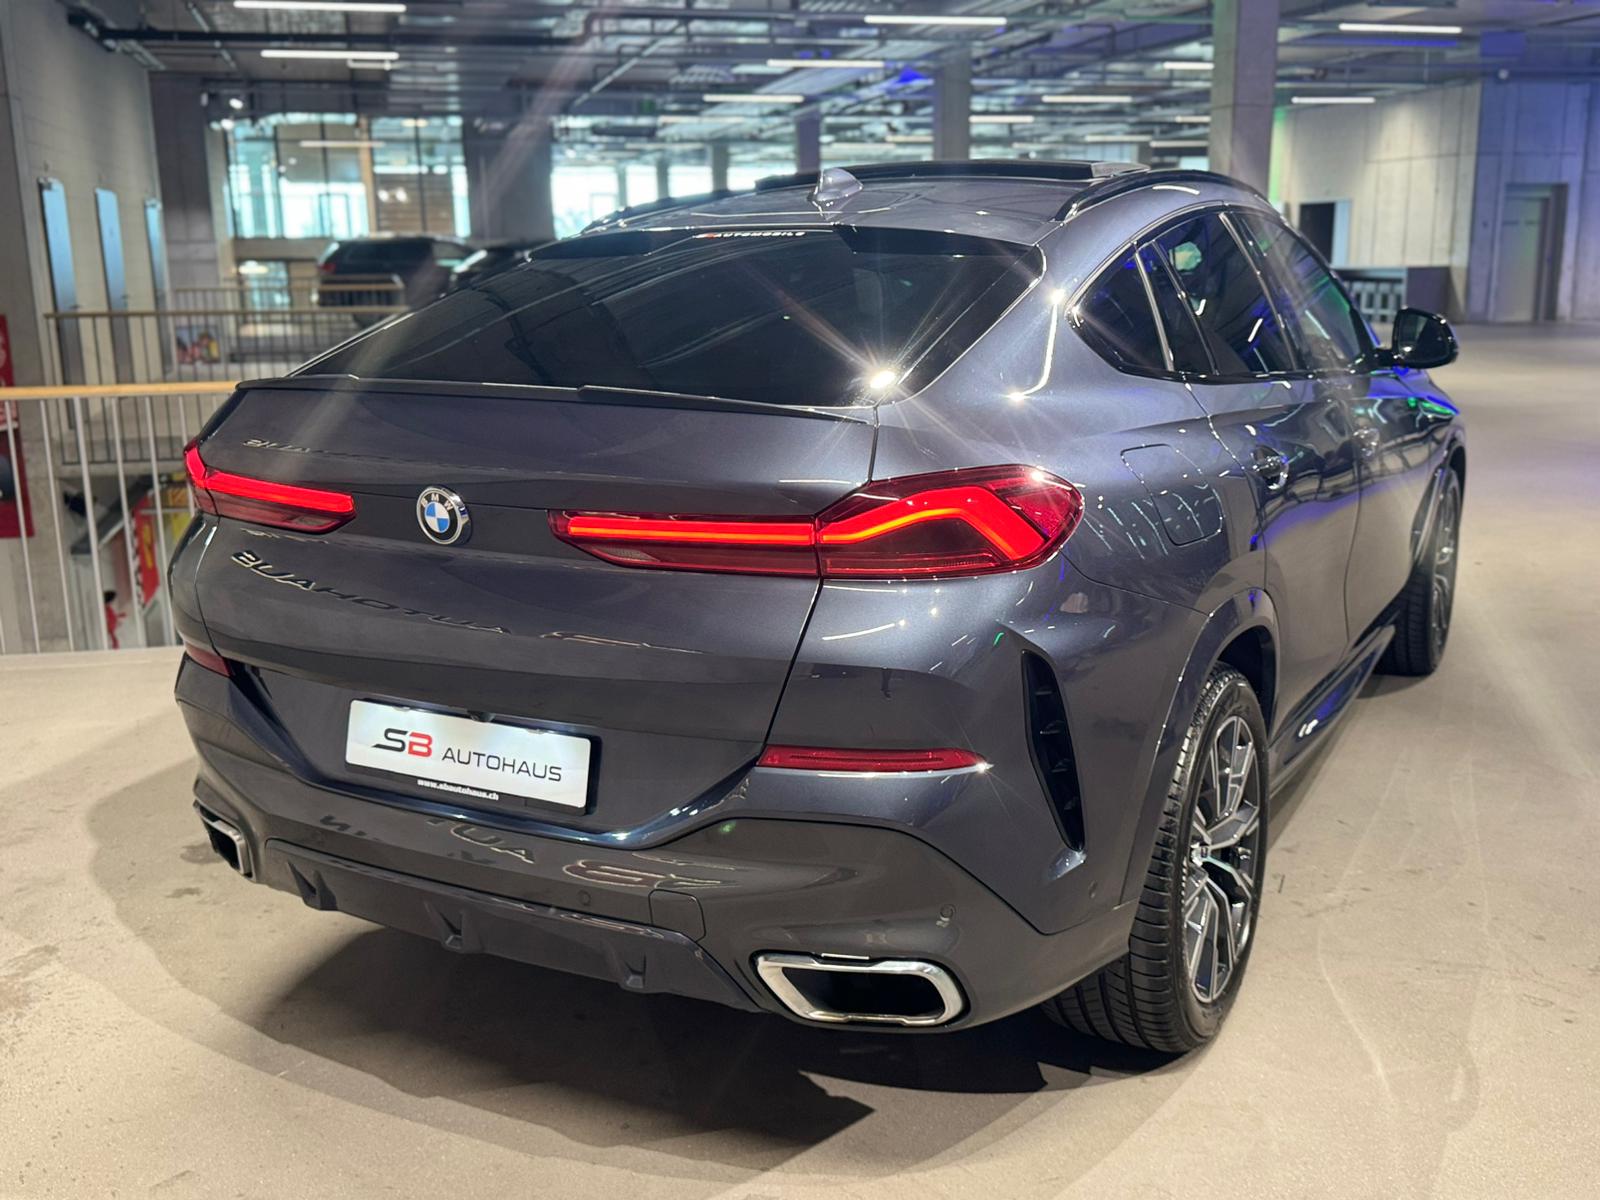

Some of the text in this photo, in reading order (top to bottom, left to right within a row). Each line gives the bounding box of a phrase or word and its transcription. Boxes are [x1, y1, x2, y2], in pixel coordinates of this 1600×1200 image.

[420, 493, 454, 511] BMW
[371, 728, 562, 782] SB AUTOHAUS
